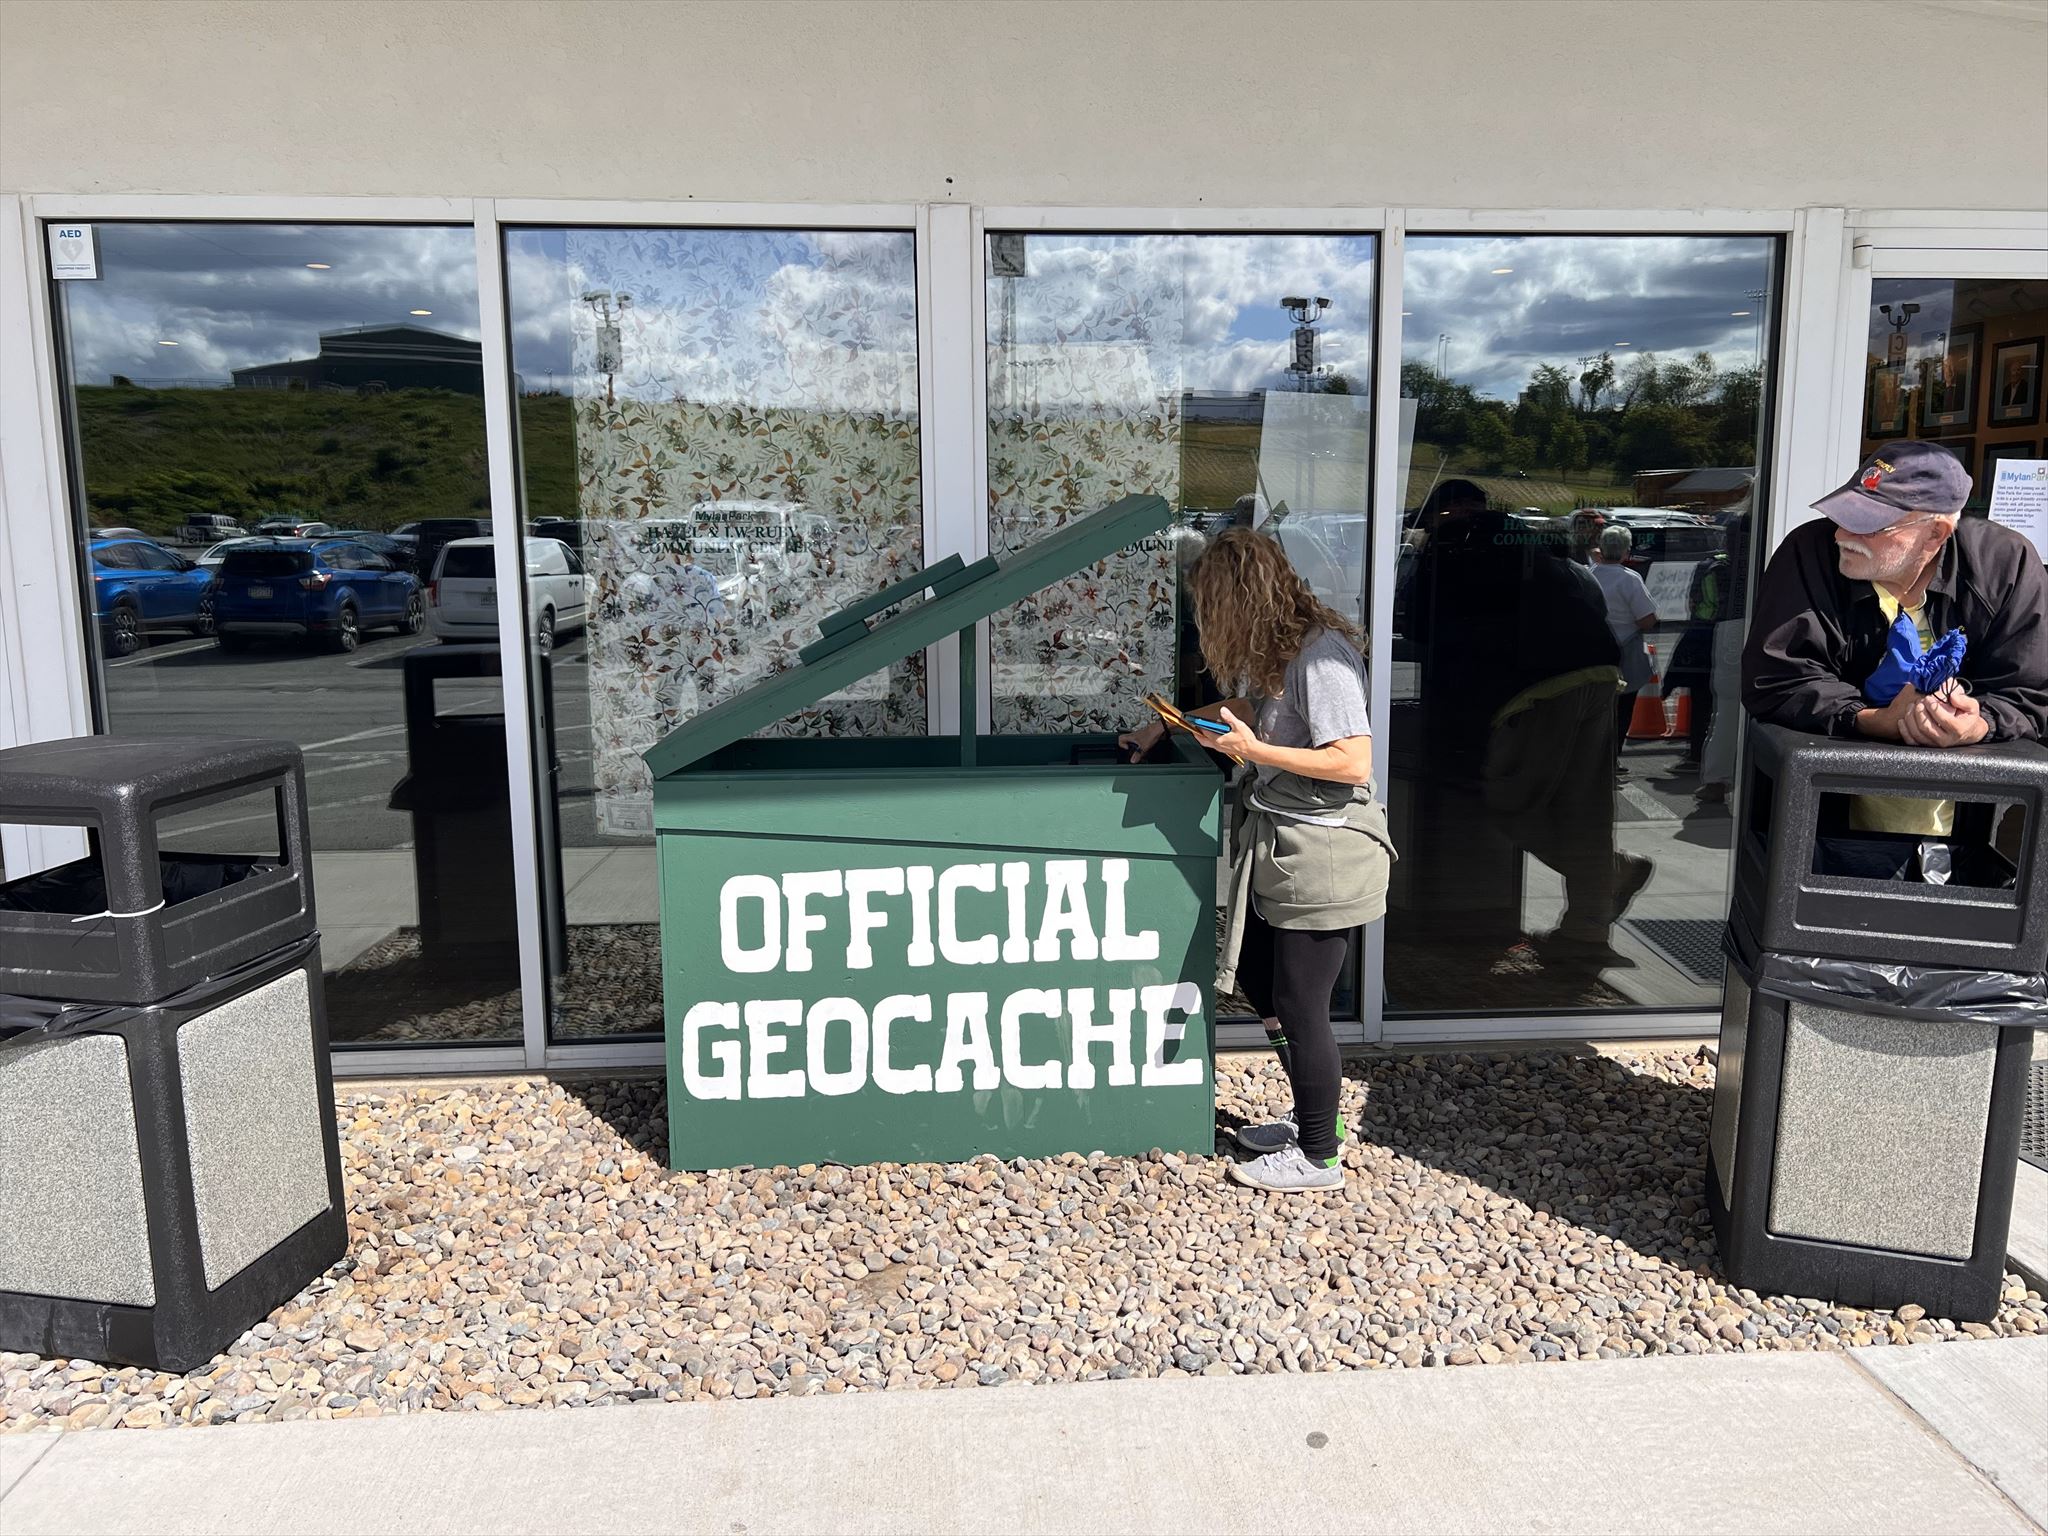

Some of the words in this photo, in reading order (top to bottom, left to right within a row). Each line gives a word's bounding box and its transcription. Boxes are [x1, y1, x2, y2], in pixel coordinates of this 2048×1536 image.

[59, 229, 82, 238] AED
[709, 526, 719, 539] &
[755, 526, 799, 539] RUBY
[1492, 532, 1593, 546] COMMUNITY
[638, 540, 742, 554] COMMUNITY
[719, 858, 1160, 974] OFFICIAL
[682, 981, 1204, 1101] GEOCACHE
